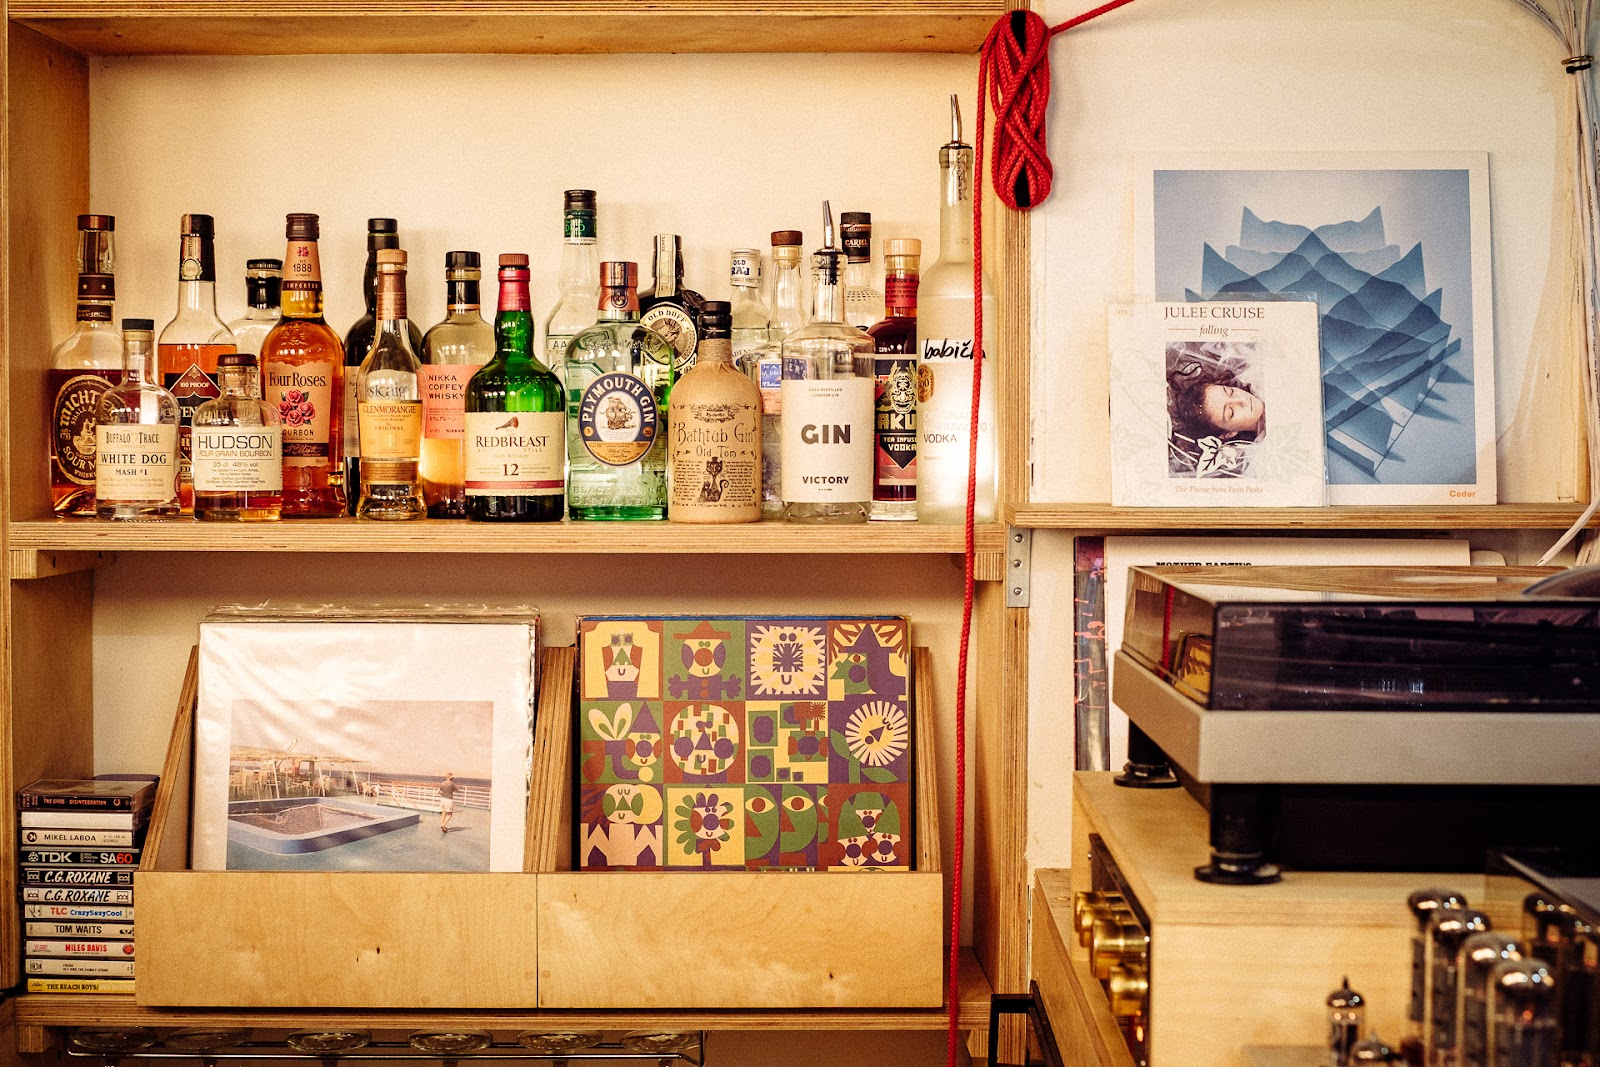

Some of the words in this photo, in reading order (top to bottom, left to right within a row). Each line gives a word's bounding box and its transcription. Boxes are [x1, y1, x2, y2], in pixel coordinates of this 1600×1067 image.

[293, 263, 312, 272] 1888
[731, 266, 750, 276] RAJ
[647, 310, 664, 322] OLD
[1164, 306, 1208, 319] JULEE
[1211, 306, 1266, 318] CRUISE
[1199, 325, 1231, 337] falling
[269, 371, 295, 387] Four
[428, 374, 457, 382] NIKKA
[428, 383, 464, 391] COFFEY
[428, 392, 465, 400] WHISKY
[581, 376, 644, 423] PLYMOUTH
[640, 394, 655, 423] GIN
[362, 404, 417, 414] GLENMORANGIE
[106, 431, 131, 444] BUFFALO
[139, 431, 160, 444] TRACE
[677, 421, 728, 446] Bathtub
[734, 421, 753, 443] Gin
[800, 423, 851, 445] GIN
[923, 433, 958, 444] VODKA
[198, 435, 273, 449] HUDSON
[475, 435, 548, 448] REDBREAST
[696, 445, 712, 457] Old
[717, 445, 737, 458] Tom
[887, 443, 917, 452] VODKA
[62, 446, 86, 469] SOUR
[100, 454, 137, 464] WHITE
[141, 454, 168, 464] DOG
[115, 468, 137, 476] MASH
[502, 463, 520, 477] 12
[802, 476, 849, 484] VICTORY
[1175, 485, 1187, 493] The
[43, 797, 53, 805] THE
[44, 834, 68, 842] MIKEL
[69, 834, 97, 842] LABOA
[37, 851, 73, 863] TDK
[99, 852, 133, 864] SA60
[44, 871, 65, 884] C.G.
[65, 871, 113, 884] ROXANE
[44, 890, 65, 902] C.G.
[65, 890, 112, 903] ROXANE
[50, 907, 68, 915] TLC
[69, 909, 123, 918] CrazySexyCool
[54, 924, 73, 934] TOM
[75, 924, 103, 935] WAITS
[65, 943, 85, 952] MILES
[86, 943, 108, 953] DAVIS
[59, 983, 81, 991] BEACH
